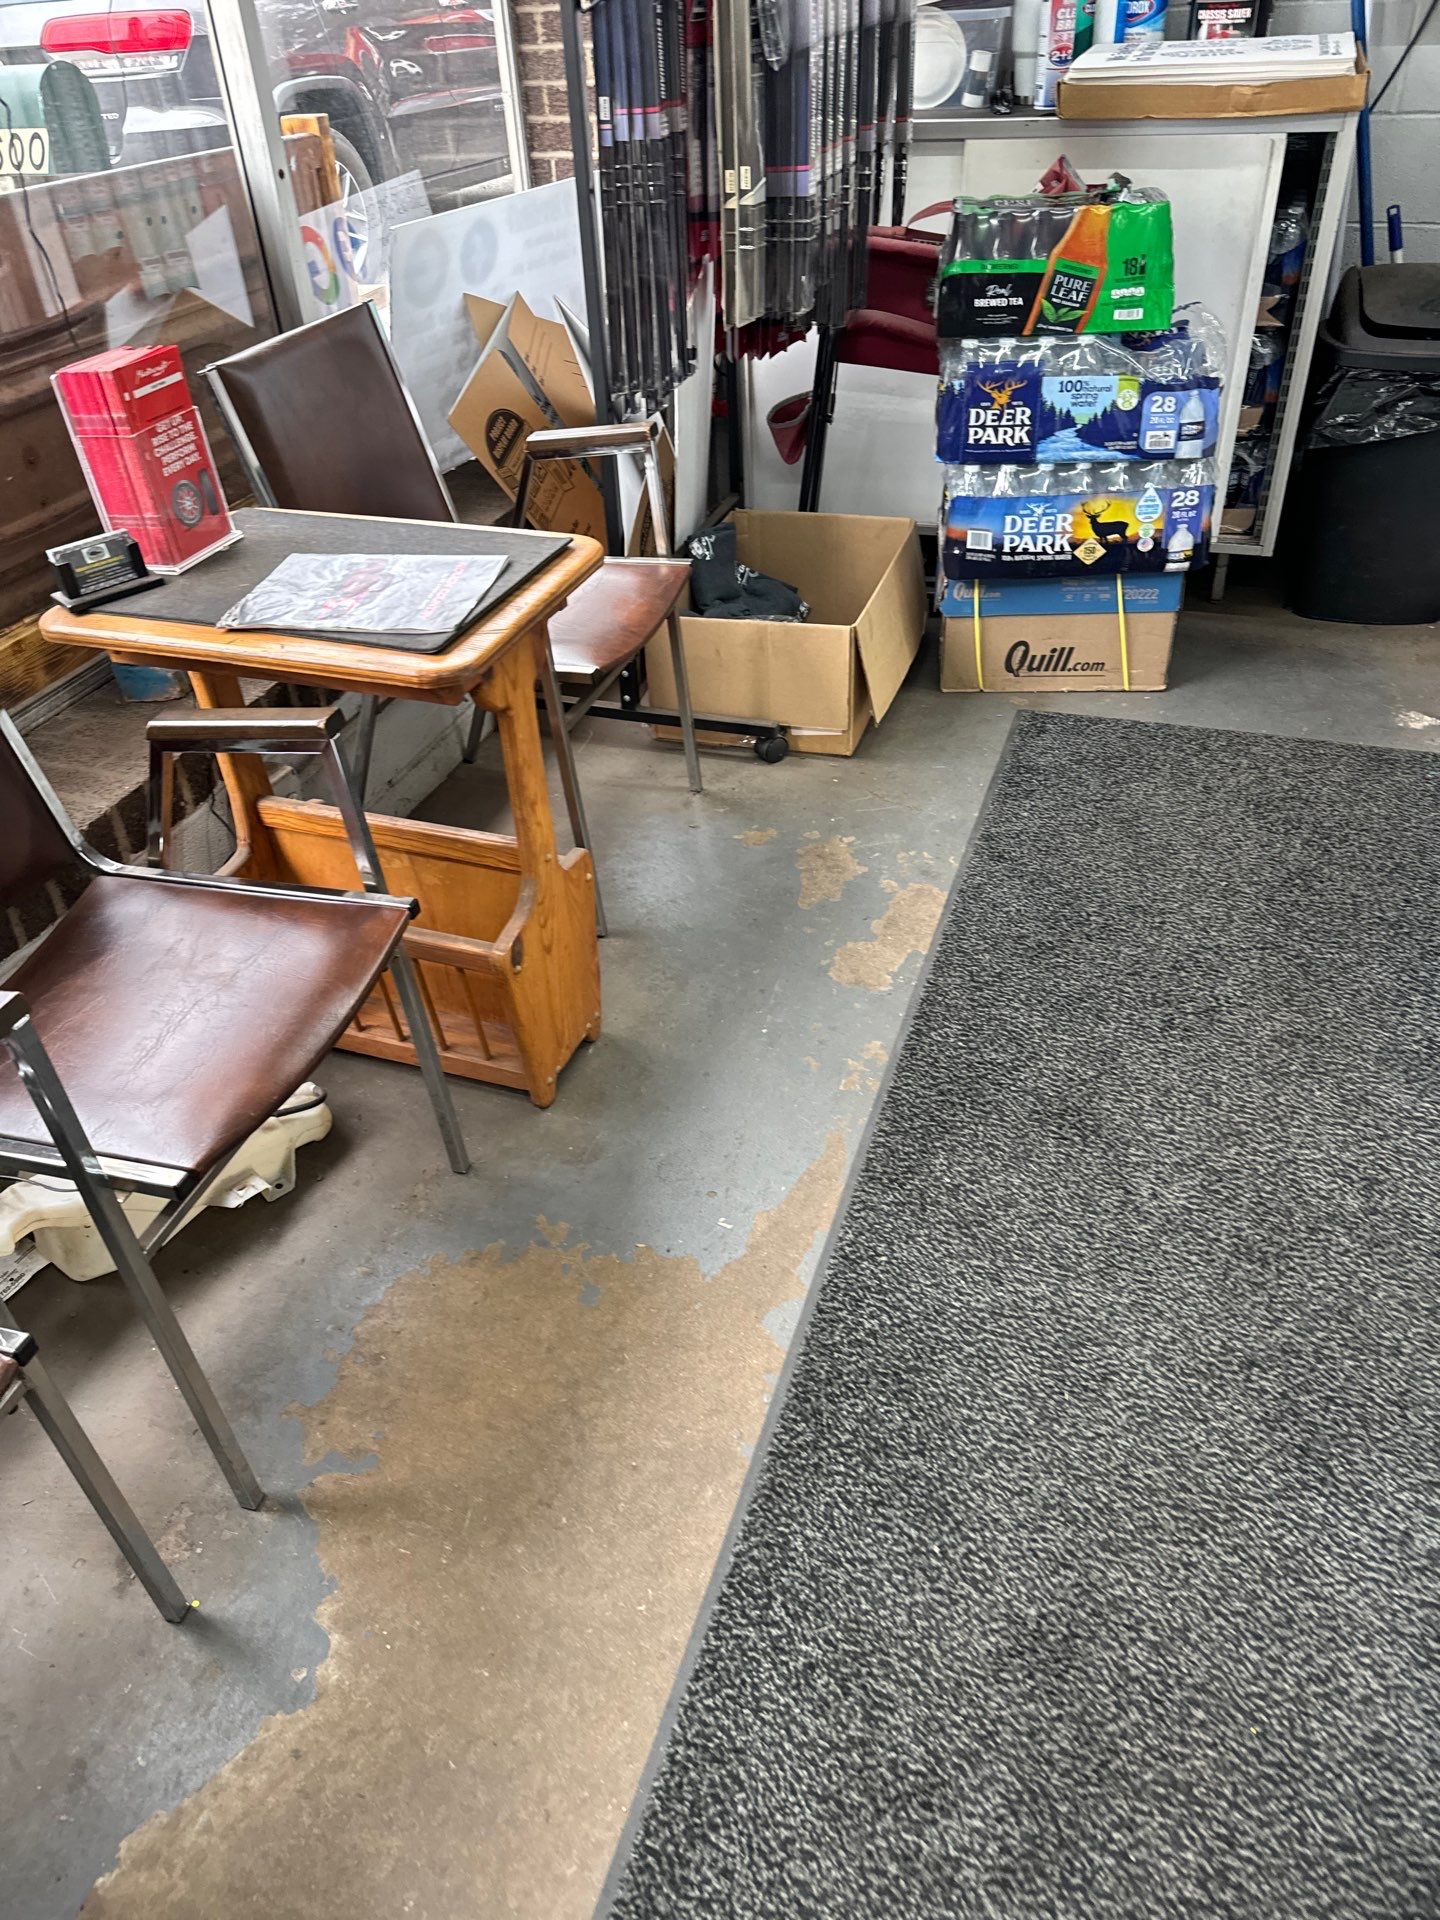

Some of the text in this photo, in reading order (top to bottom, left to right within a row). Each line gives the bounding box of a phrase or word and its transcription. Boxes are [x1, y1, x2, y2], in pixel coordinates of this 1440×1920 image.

[1198, 9, 1226, 20] CHASSIS
[0, 131, 45, 171] 00
[1055, 274, 1092, 292] PURE
[973, 297, 1024, 307] BREWED TEA
[1051, 285, 1088, 302] LEAF
[1150, 395, 1177, 413] 28
[968, 408, 1032, 427] DEER
[967, 427, 1032, 446] PARK
[1171, 490, 1200, 508] 28
[1003, 513, 1074, 533] DEER
[1002, 534, 1074, 555] PARK
[1004, 640, 1106, 677] Quill.com
